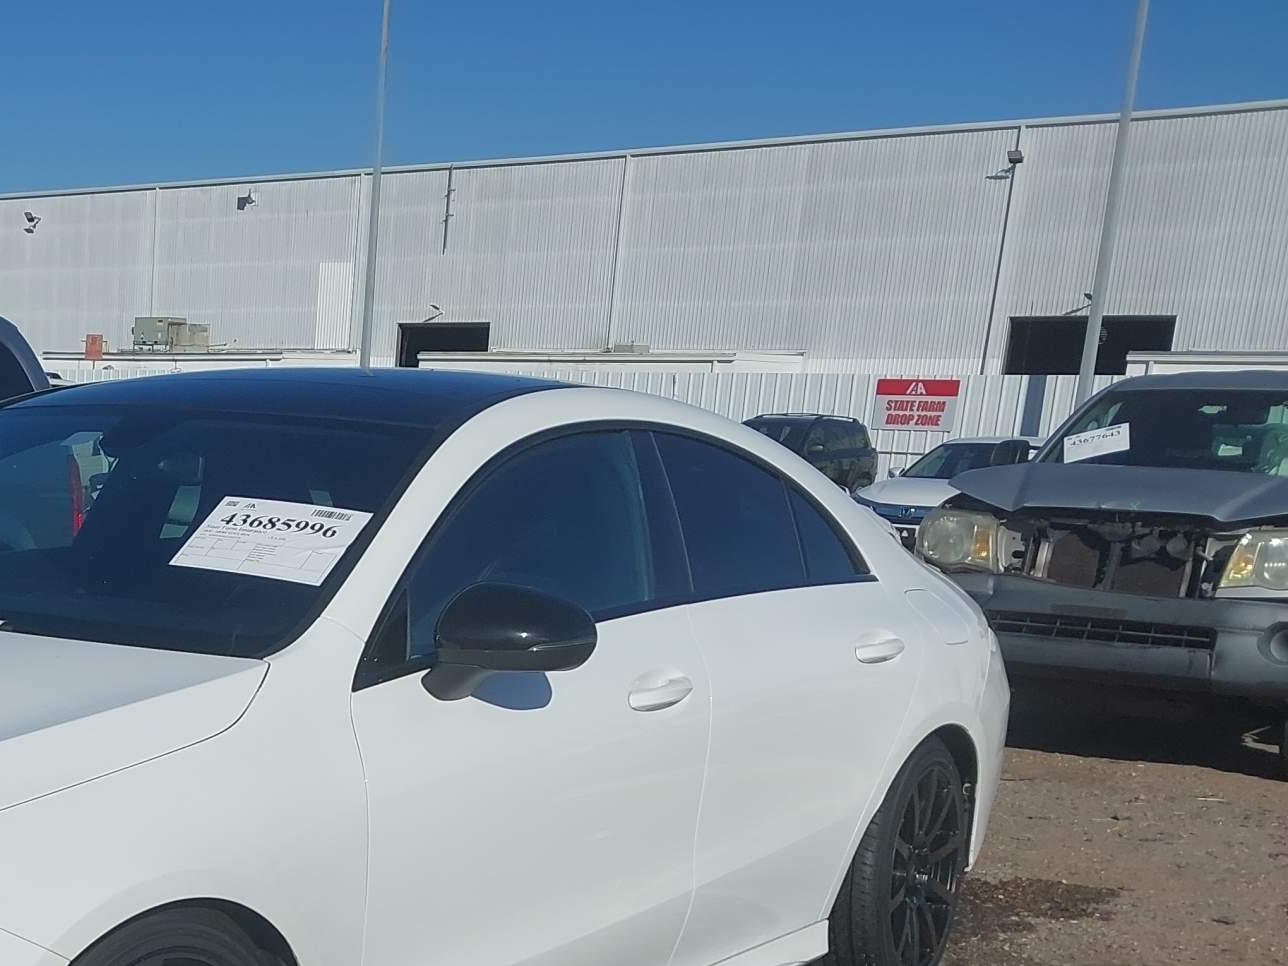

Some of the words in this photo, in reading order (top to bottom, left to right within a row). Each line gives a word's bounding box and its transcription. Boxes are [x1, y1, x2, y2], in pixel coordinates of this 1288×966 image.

[886, 400, 916, 411] STATE
[917, 401, 946, 412] FARM
[885, 414, 914, 425] DROP
[914, 415, 942, 426] ZONE
[220, 512, 341, 538] 43685996
